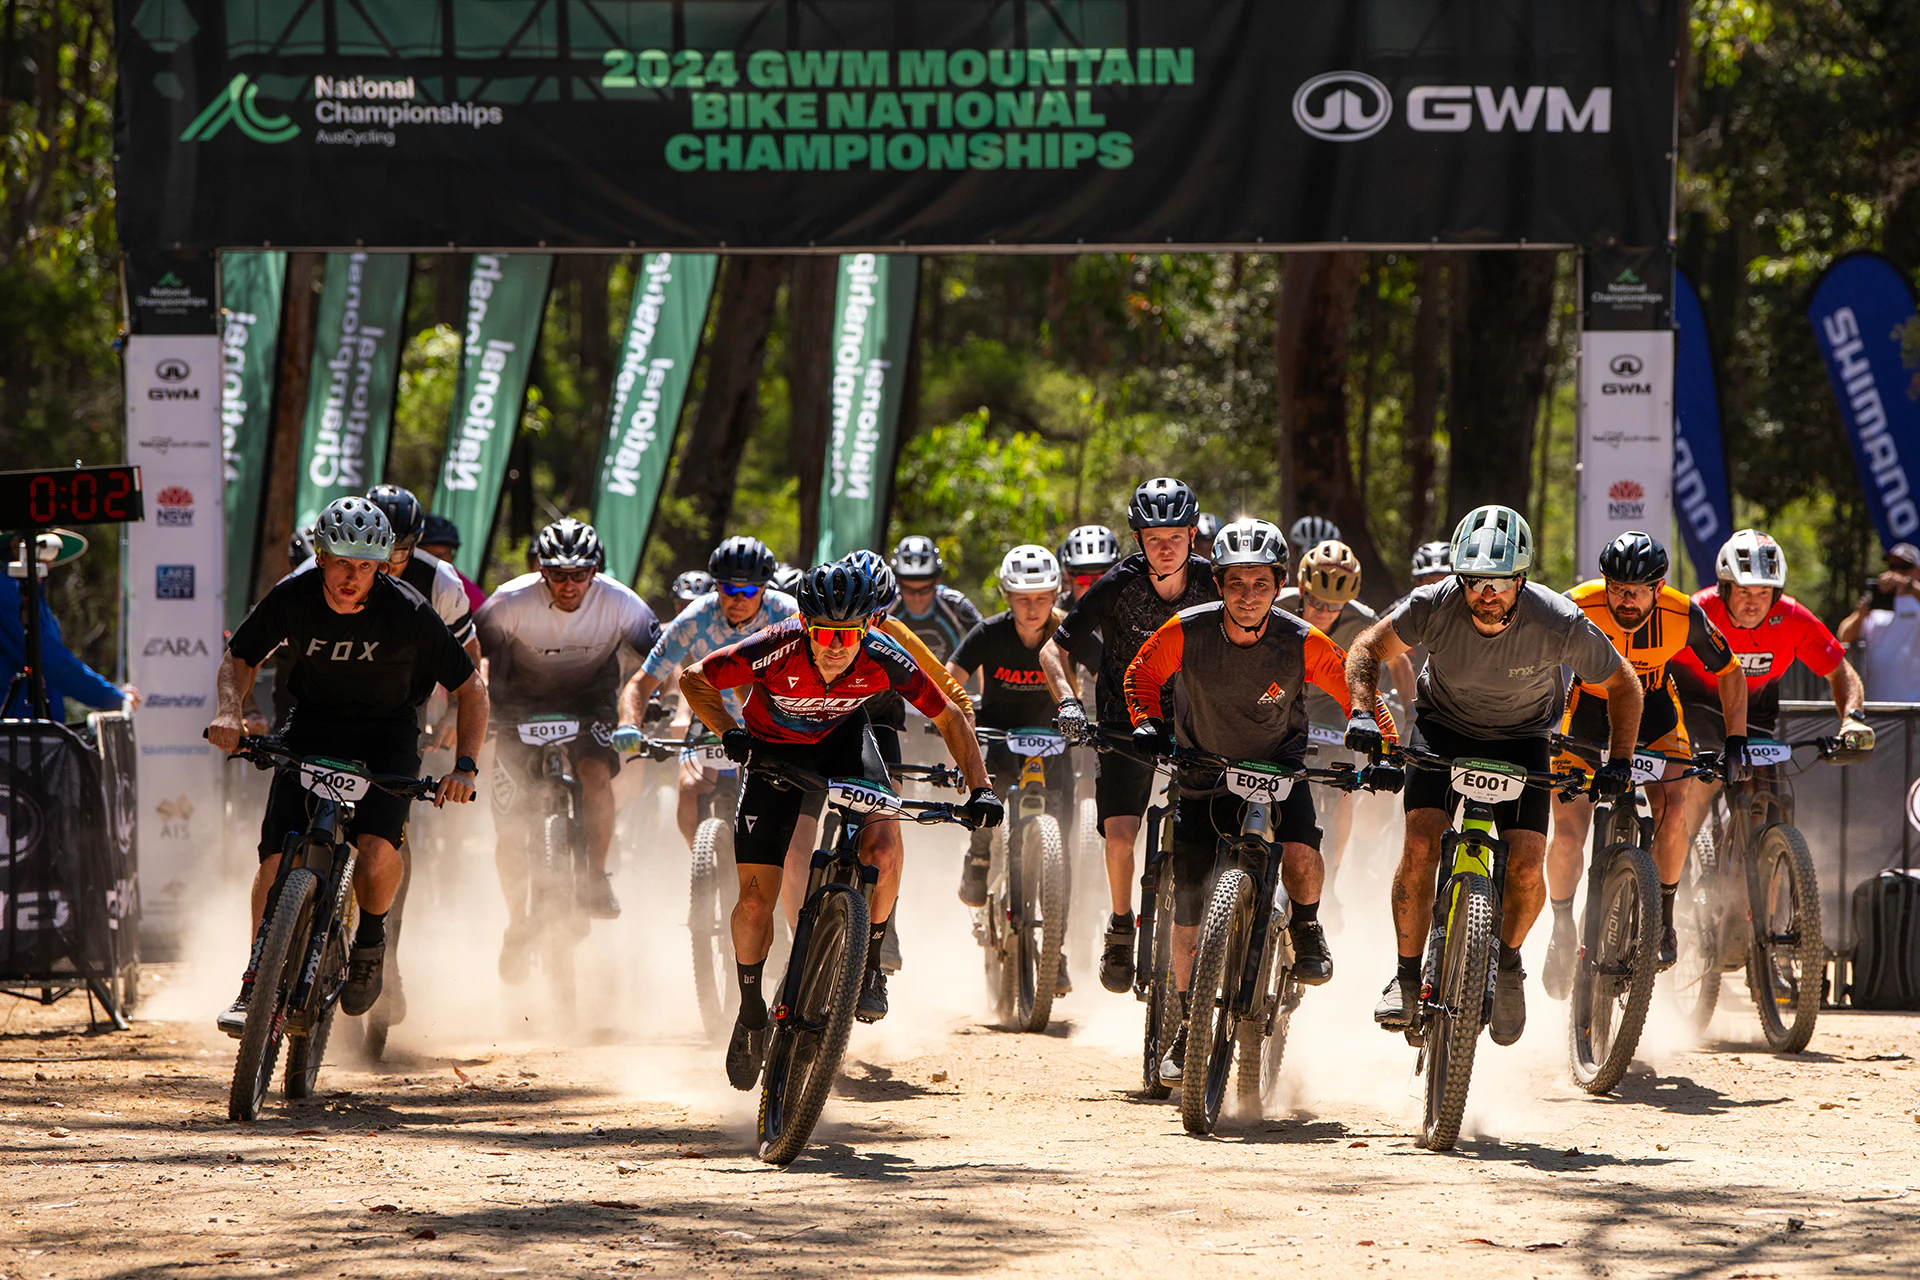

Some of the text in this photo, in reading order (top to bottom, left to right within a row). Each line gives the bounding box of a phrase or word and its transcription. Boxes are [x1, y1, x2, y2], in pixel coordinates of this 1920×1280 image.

[602, 48, 1194, 88] 2024 GWM MOUNTAIN
[315, 76, 414, 99] National
[315, 102, 502, 128] Championships
[691, 91, 1106, 129] BIKE NATIONAL
[1407, 86, 1612, 133] GWM
[315, 129, 395, 146] AusCycling
[665, 132, 1134, 171] CHAMPIONSHIPS
[148, 388, 199, 400] GWM
[1602, 383, 1651, 395] GWM
[1823, 306, 1919, 539] SHIMANO
[30, 471, 131, 522] 0:02
[157, 508, 194, 521] NSW
[1608, 503, 1645, 514] NSW
[306, 637, 380, 662] FOX
[752, 638, 800, 672] GIANT
[868, 640, 918, 673] GIANT
[994, 666, 1046, 684] MAXX
[1508, 665, 1535, 678] FOX
[770, 694, 875, 708] GIANT
[529, 724, 567, 736] E019
[1308, 726, 1339, 740] 013
[706, 747, 724, 759] E0
[1748, 747, 1780, 757] 005
[312, 770, 356, 792] E002
[1236, 774, 1280, 792] E020
[1463, 772, 1509, 792] E001
[841, 786, 888, 809] E004
[160, 825, 190, 840] AIS
